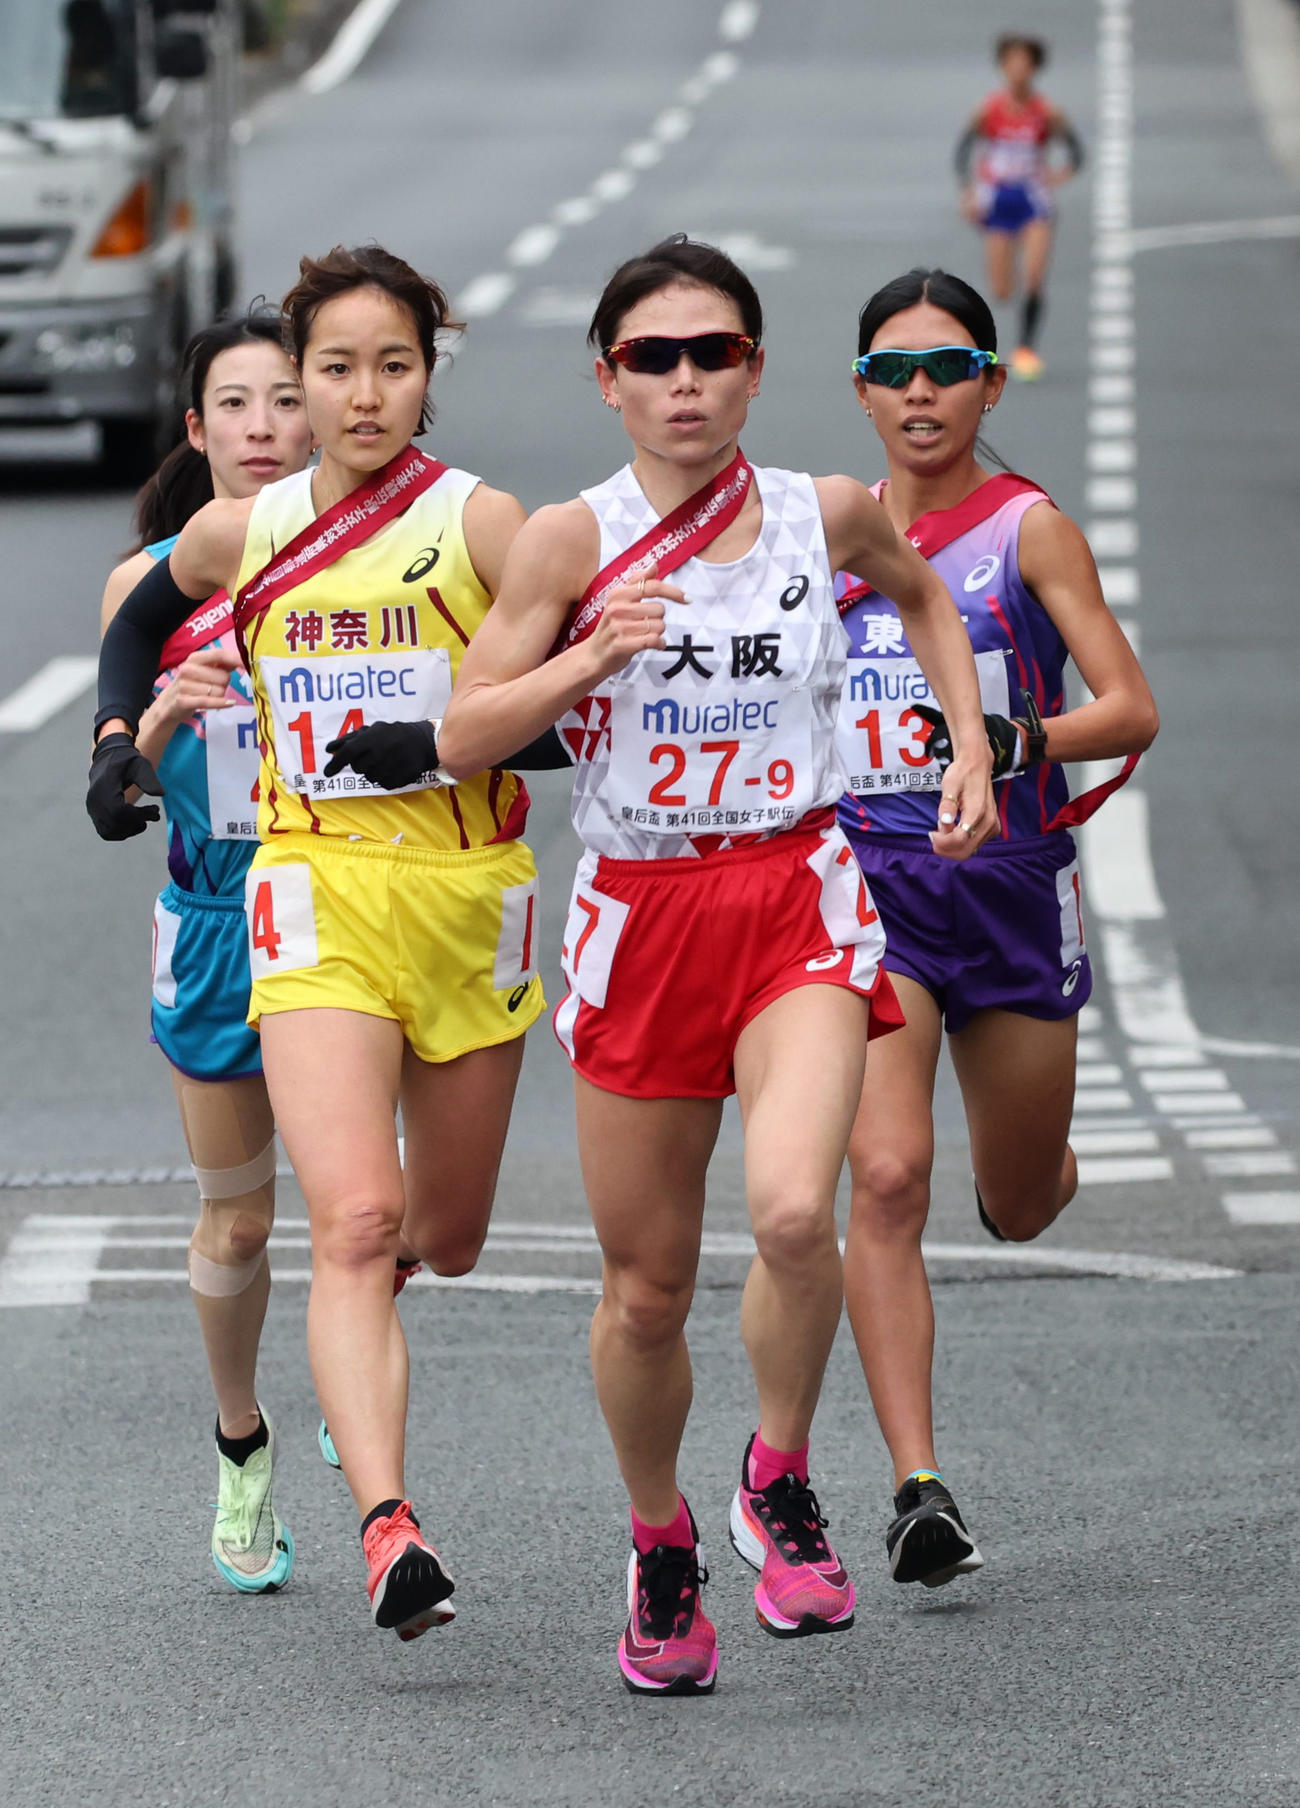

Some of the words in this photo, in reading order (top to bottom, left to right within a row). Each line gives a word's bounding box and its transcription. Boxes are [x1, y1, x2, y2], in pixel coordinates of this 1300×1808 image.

[285, 605, 419, 652] 神奈川
[661, 633, 783, 680] 大阪
[850, 667, 936, 702] mura
[855, 707, 936, 769] 13
[850, 775, 875, 789] 后盃
[880, 772, 944, 787] 第41回全国
[227, 821, 258, 835] 皇后
[622, 806, 660, 826] 皇后盃
[666, 806, 796, 828] 第41回全国女子駅伝
[253, 881, 281, 961] 4
[562, 894, 601, 975] 7
